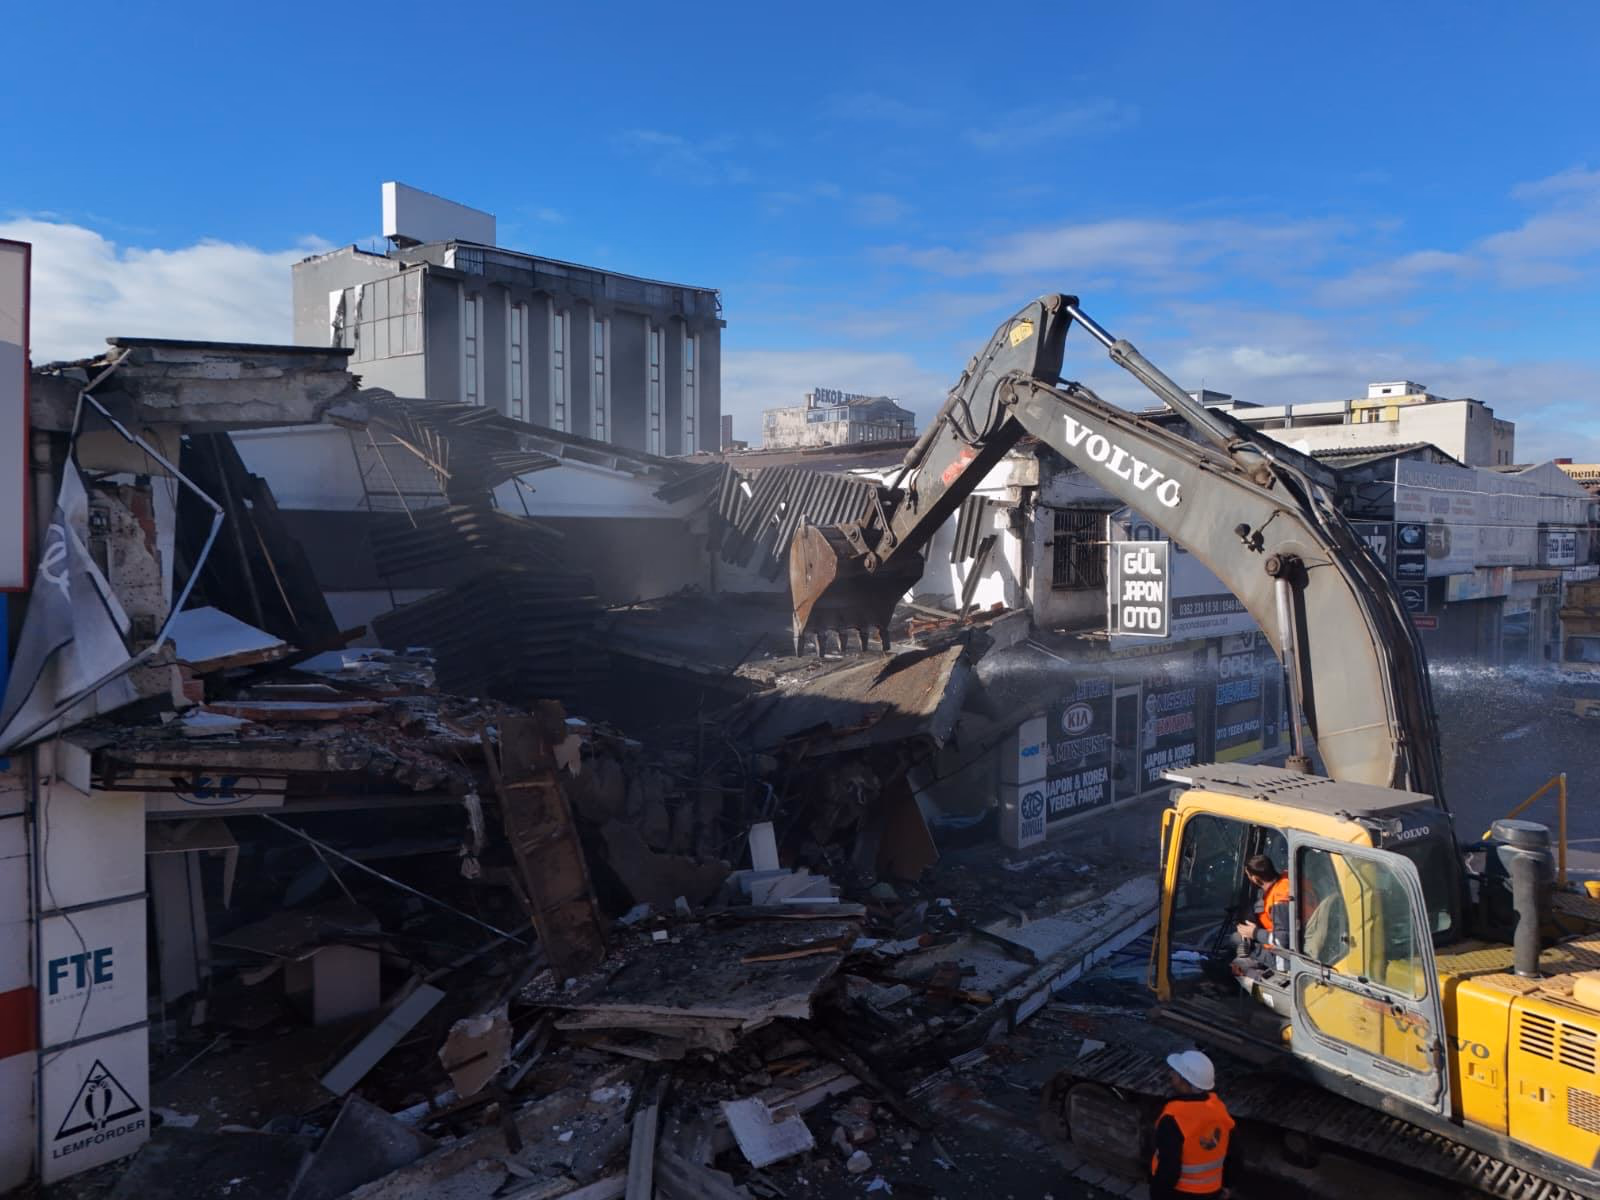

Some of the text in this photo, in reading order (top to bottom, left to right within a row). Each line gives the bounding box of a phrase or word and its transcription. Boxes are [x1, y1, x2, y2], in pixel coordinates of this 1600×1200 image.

[1064, 414, 1181, 507] VOLVO
[1123, 547, 1162, 575] GÜL
[1123, 581, 1163, 602] JAPON
[1123, 606, 1162, 629] OTO
[1219, 652, 1256, 678] OPEL
[1067, 710, 1089, 729] KIA
[1145, 748, 1167, 769] JAPON
[1174, 743, 1196, 760] KOREA
[1074, 774, 1080, 789] &
[1082, 767, 1109, 788] KOREA
[1049, 783, 1104, 814] YEDEK PARÇA
[1396, 826, 1430, 841] VOLVO
[48, 947, 113, 996] FTE
